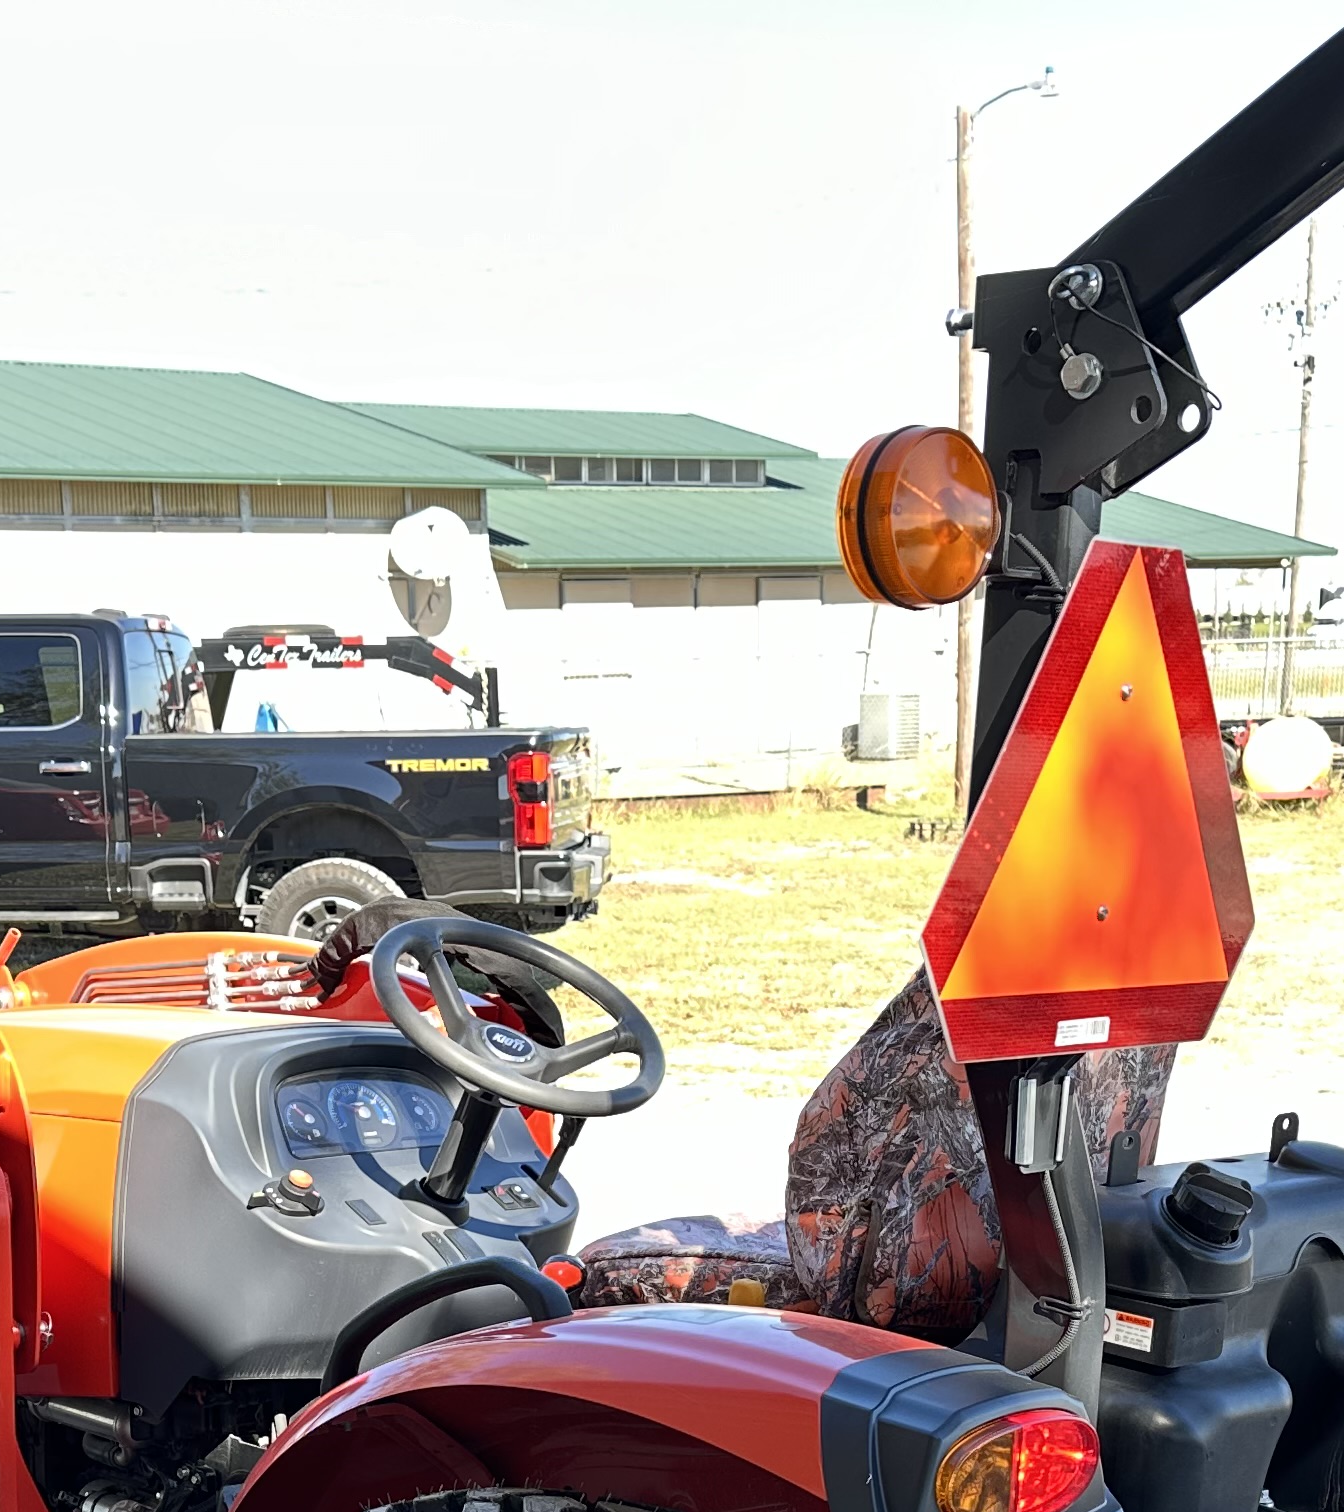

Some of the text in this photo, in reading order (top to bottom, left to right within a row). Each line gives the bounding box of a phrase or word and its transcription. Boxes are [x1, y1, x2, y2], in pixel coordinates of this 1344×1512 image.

[302, 643, 362, 663] Trailers
[385, 758, 491, 773] TREMOR
[492, 1032, 526, 1052] KIOTI
